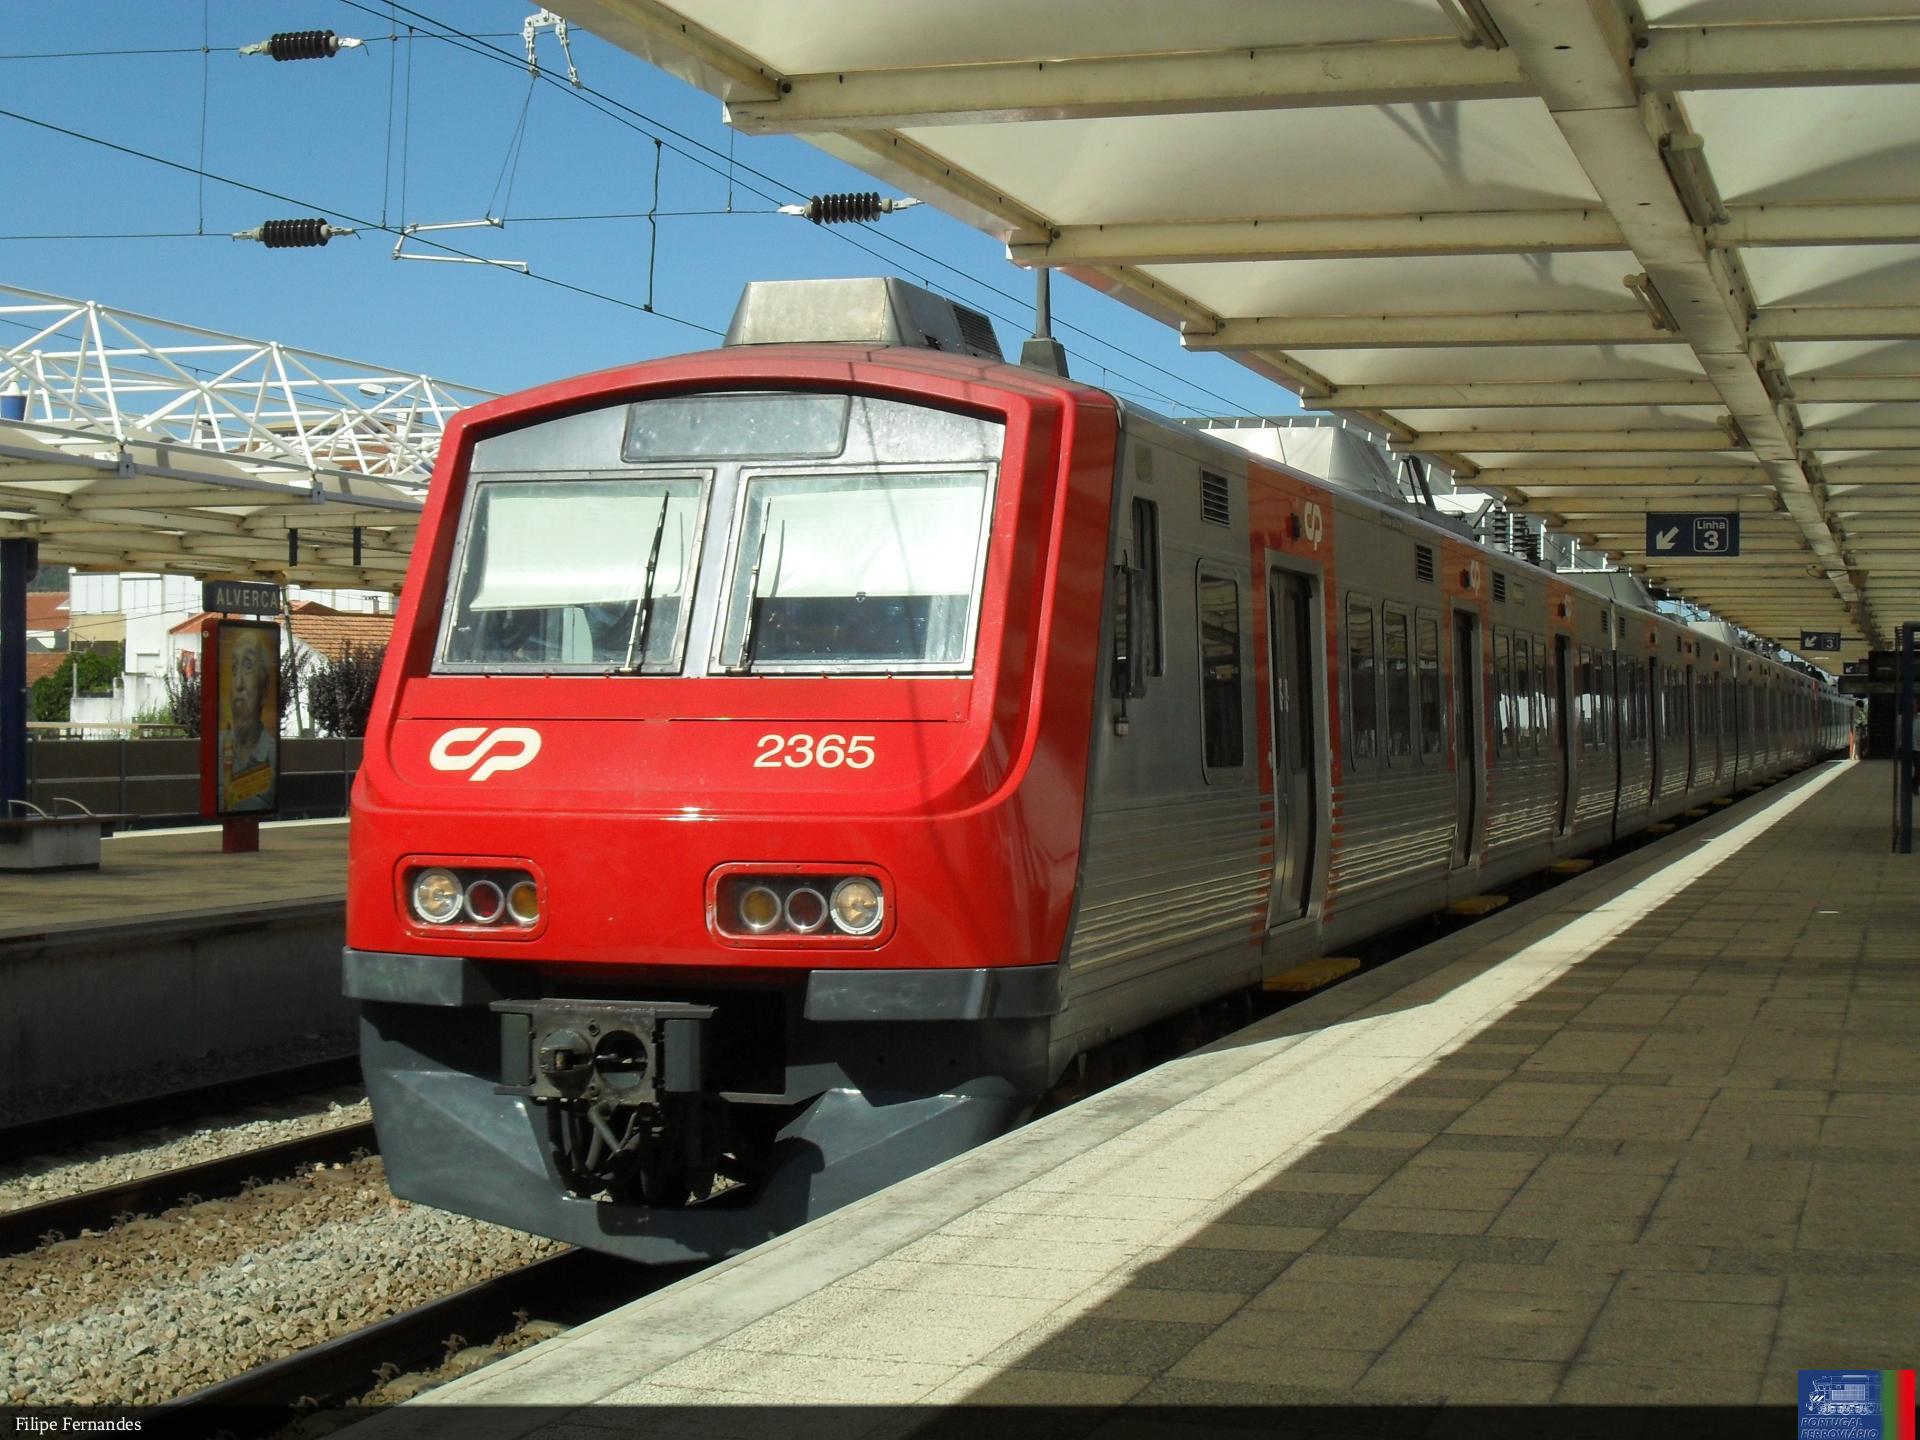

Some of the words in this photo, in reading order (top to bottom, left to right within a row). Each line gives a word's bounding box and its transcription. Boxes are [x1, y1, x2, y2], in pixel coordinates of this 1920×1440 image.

[1696, 520, 1726, 530] Linha
[1703, 531, 1719, 550] 3
[216, 587, 278, 608] ALVERCA
[1826, 639, 1834, 649] 3
[753, 734, 876, 768] 2365
